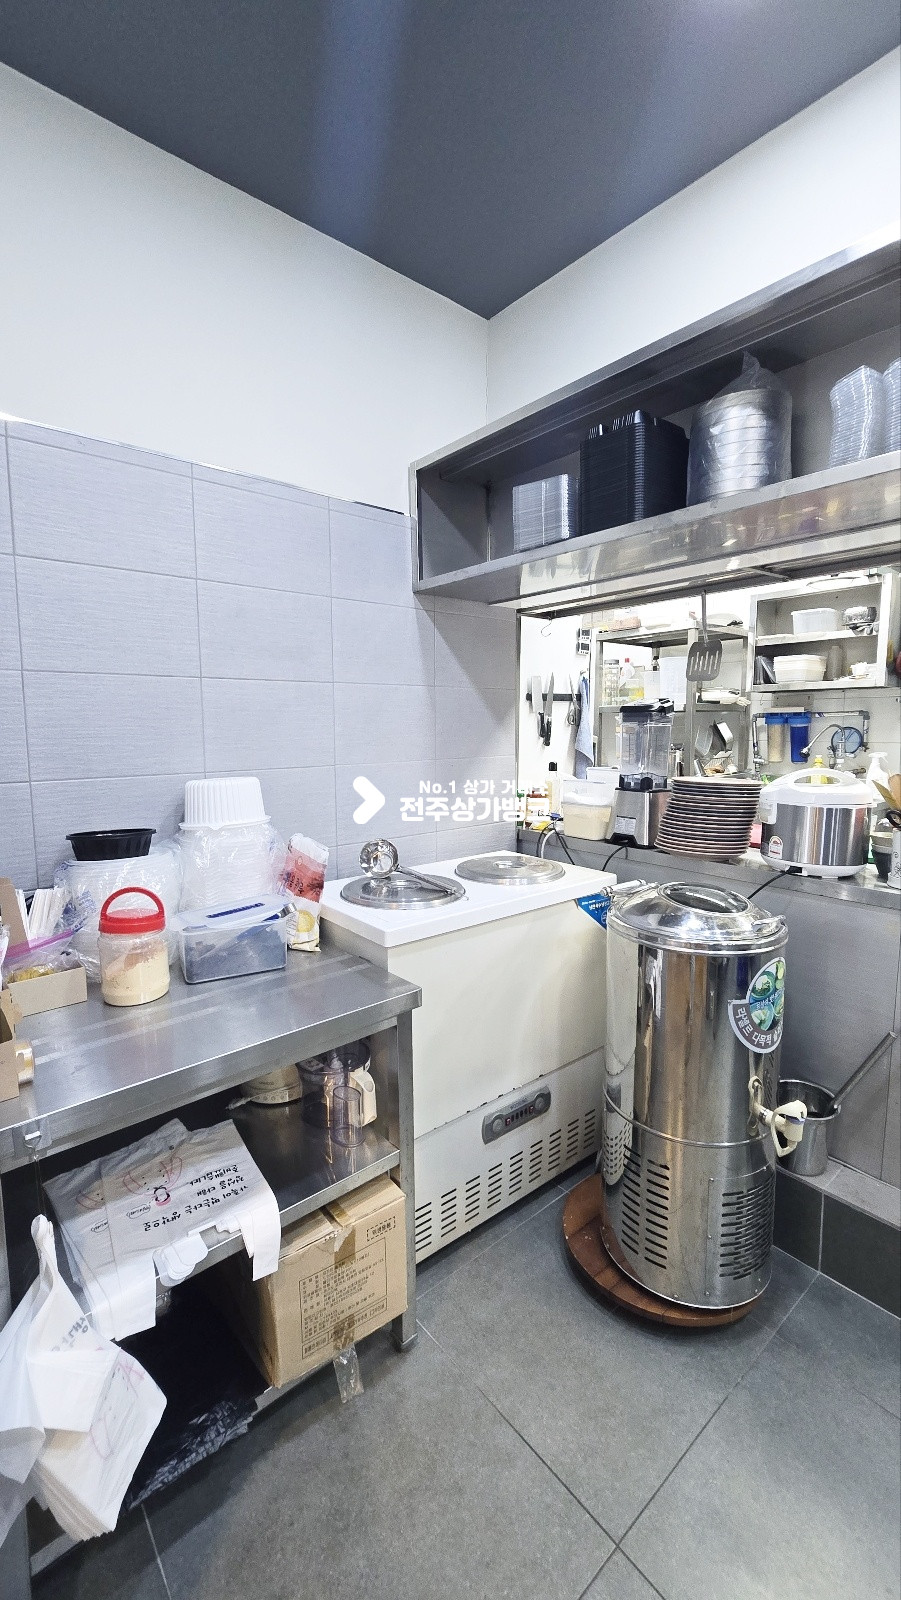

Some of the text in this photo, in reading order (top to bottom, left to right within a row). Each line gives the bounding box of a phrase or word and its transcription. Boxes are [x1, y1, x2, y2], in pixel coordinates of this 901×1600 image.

[752, 1032, 772, 1047] 다목적
[189, 1164, 239, 1187] 준비했습니다
[196, 1175, 245, 1198] 정성을 다해
[221, 1185, 249, 1200] 가족이
[184, 1196, 221, 1215] 먹는다는
[142, 1211, 182, 1232] 생각으로
